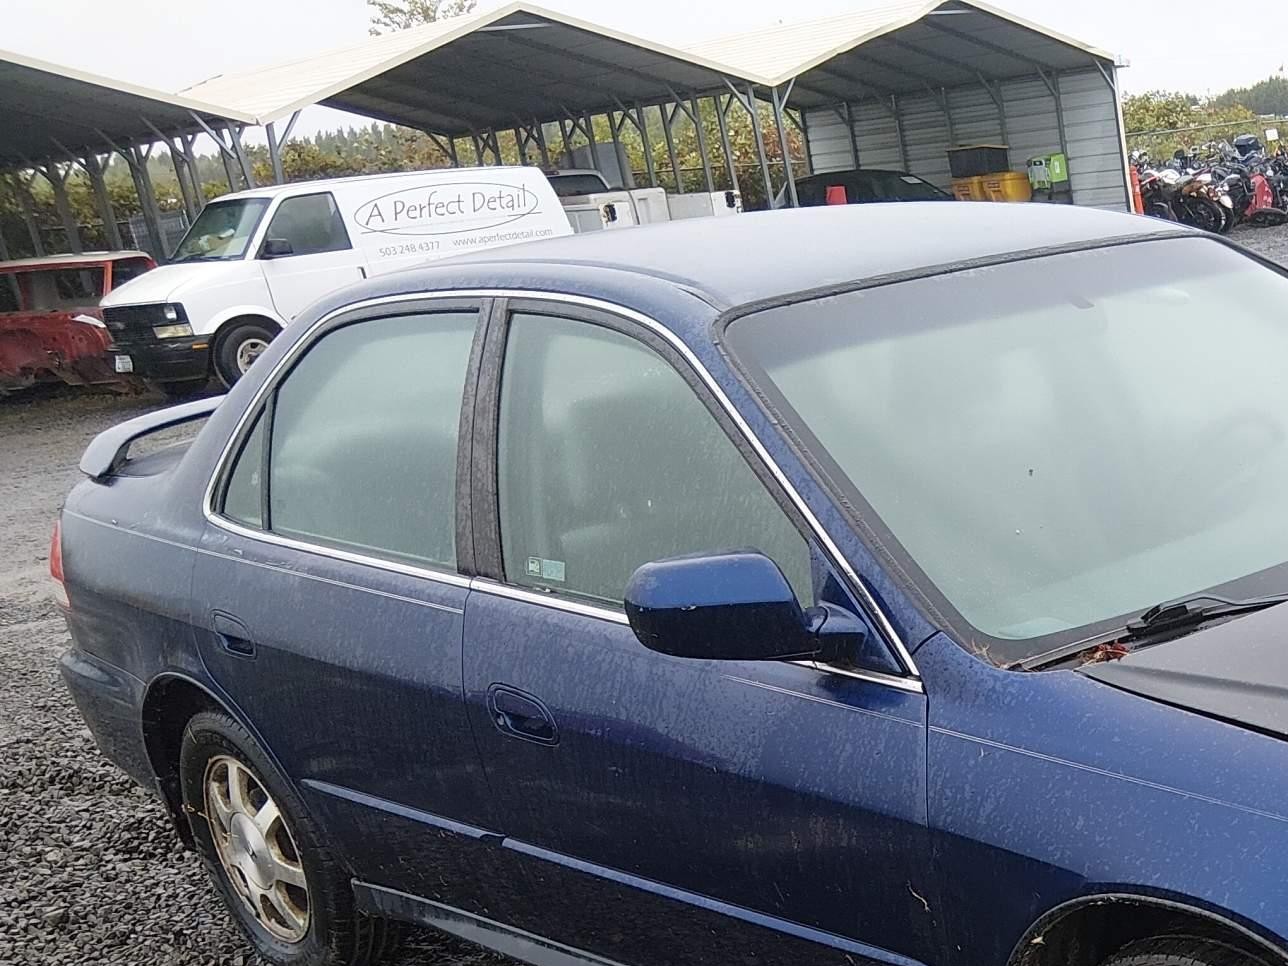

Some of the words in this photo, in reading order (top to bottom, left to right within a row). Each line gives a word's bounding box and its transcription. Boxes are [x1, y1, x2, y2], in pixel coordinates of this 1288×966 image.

[364, 203, 385, 226] A
[394, 190, 465, 221] Perfect
[472, 183, 527, 212] Detail
[379, 247, 397, 258] 503
[400, 244, 417, 255] 248
[418, 241, 440, 253] 4377
